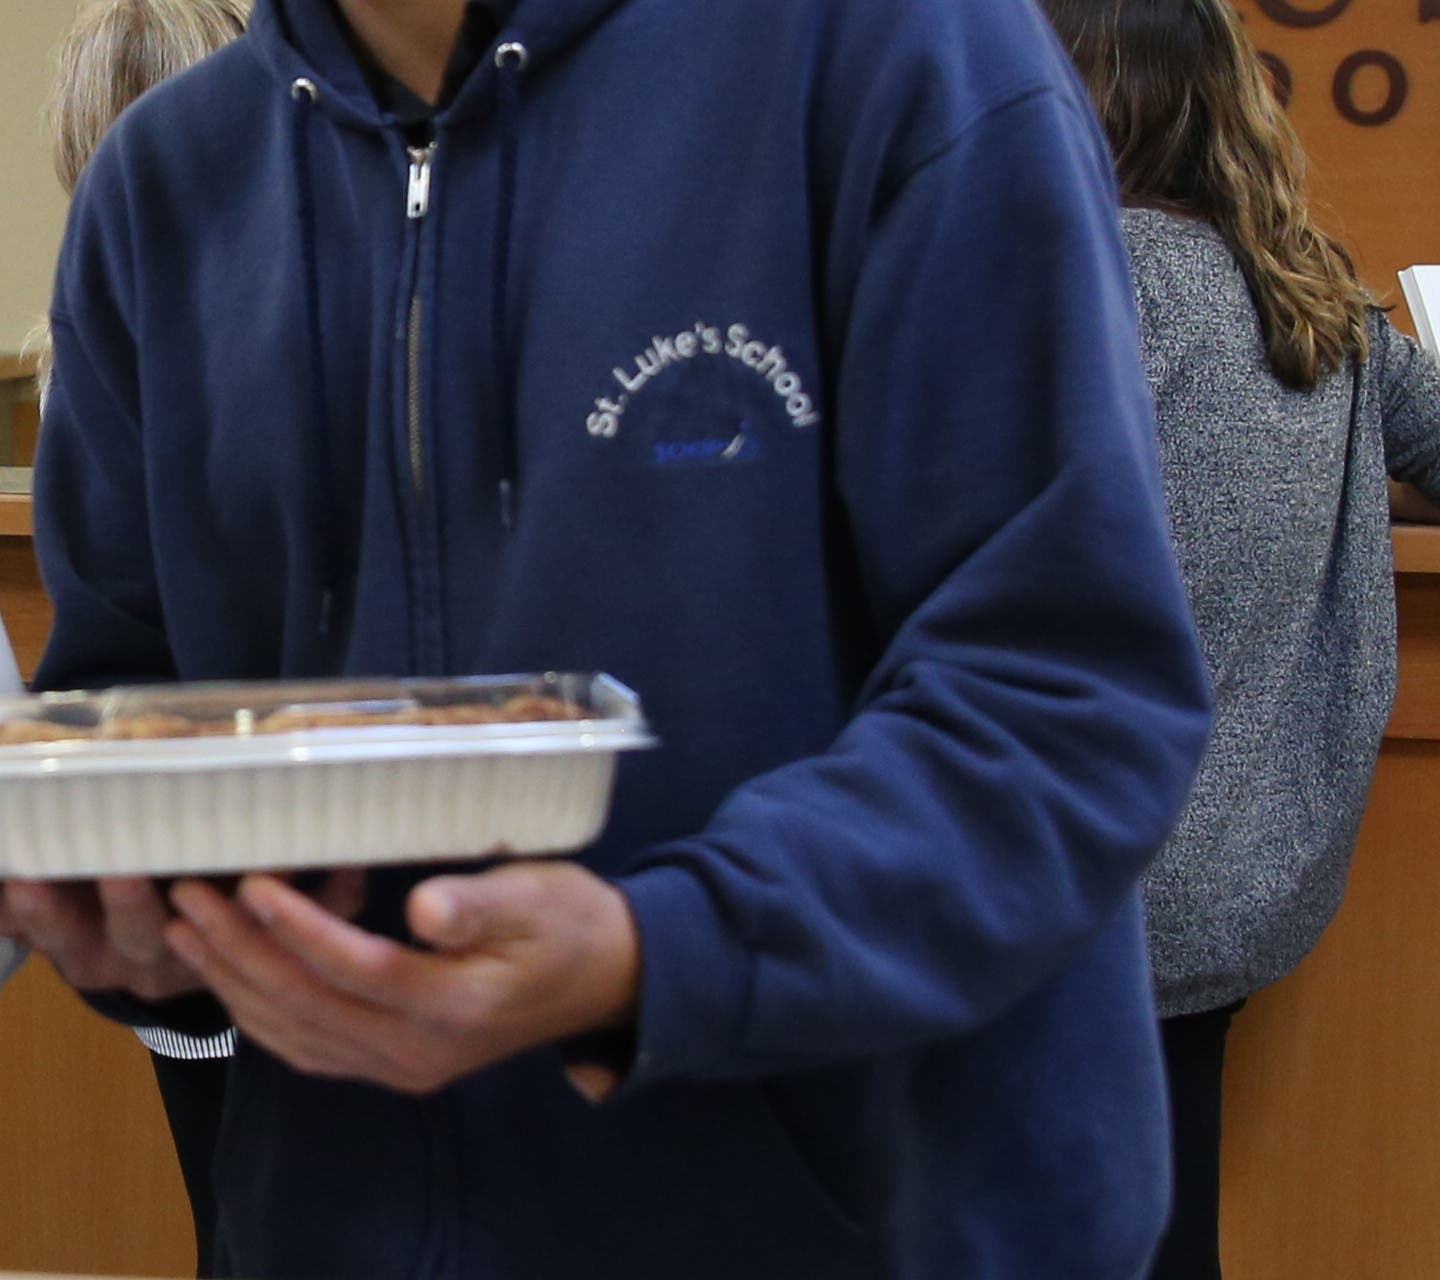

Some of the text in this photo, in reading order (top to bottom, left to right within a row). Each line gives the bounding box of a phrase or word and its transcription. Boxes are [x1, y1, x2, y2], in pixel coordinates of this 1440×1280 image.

[586, 320, 822, 439] St. Luke's School
